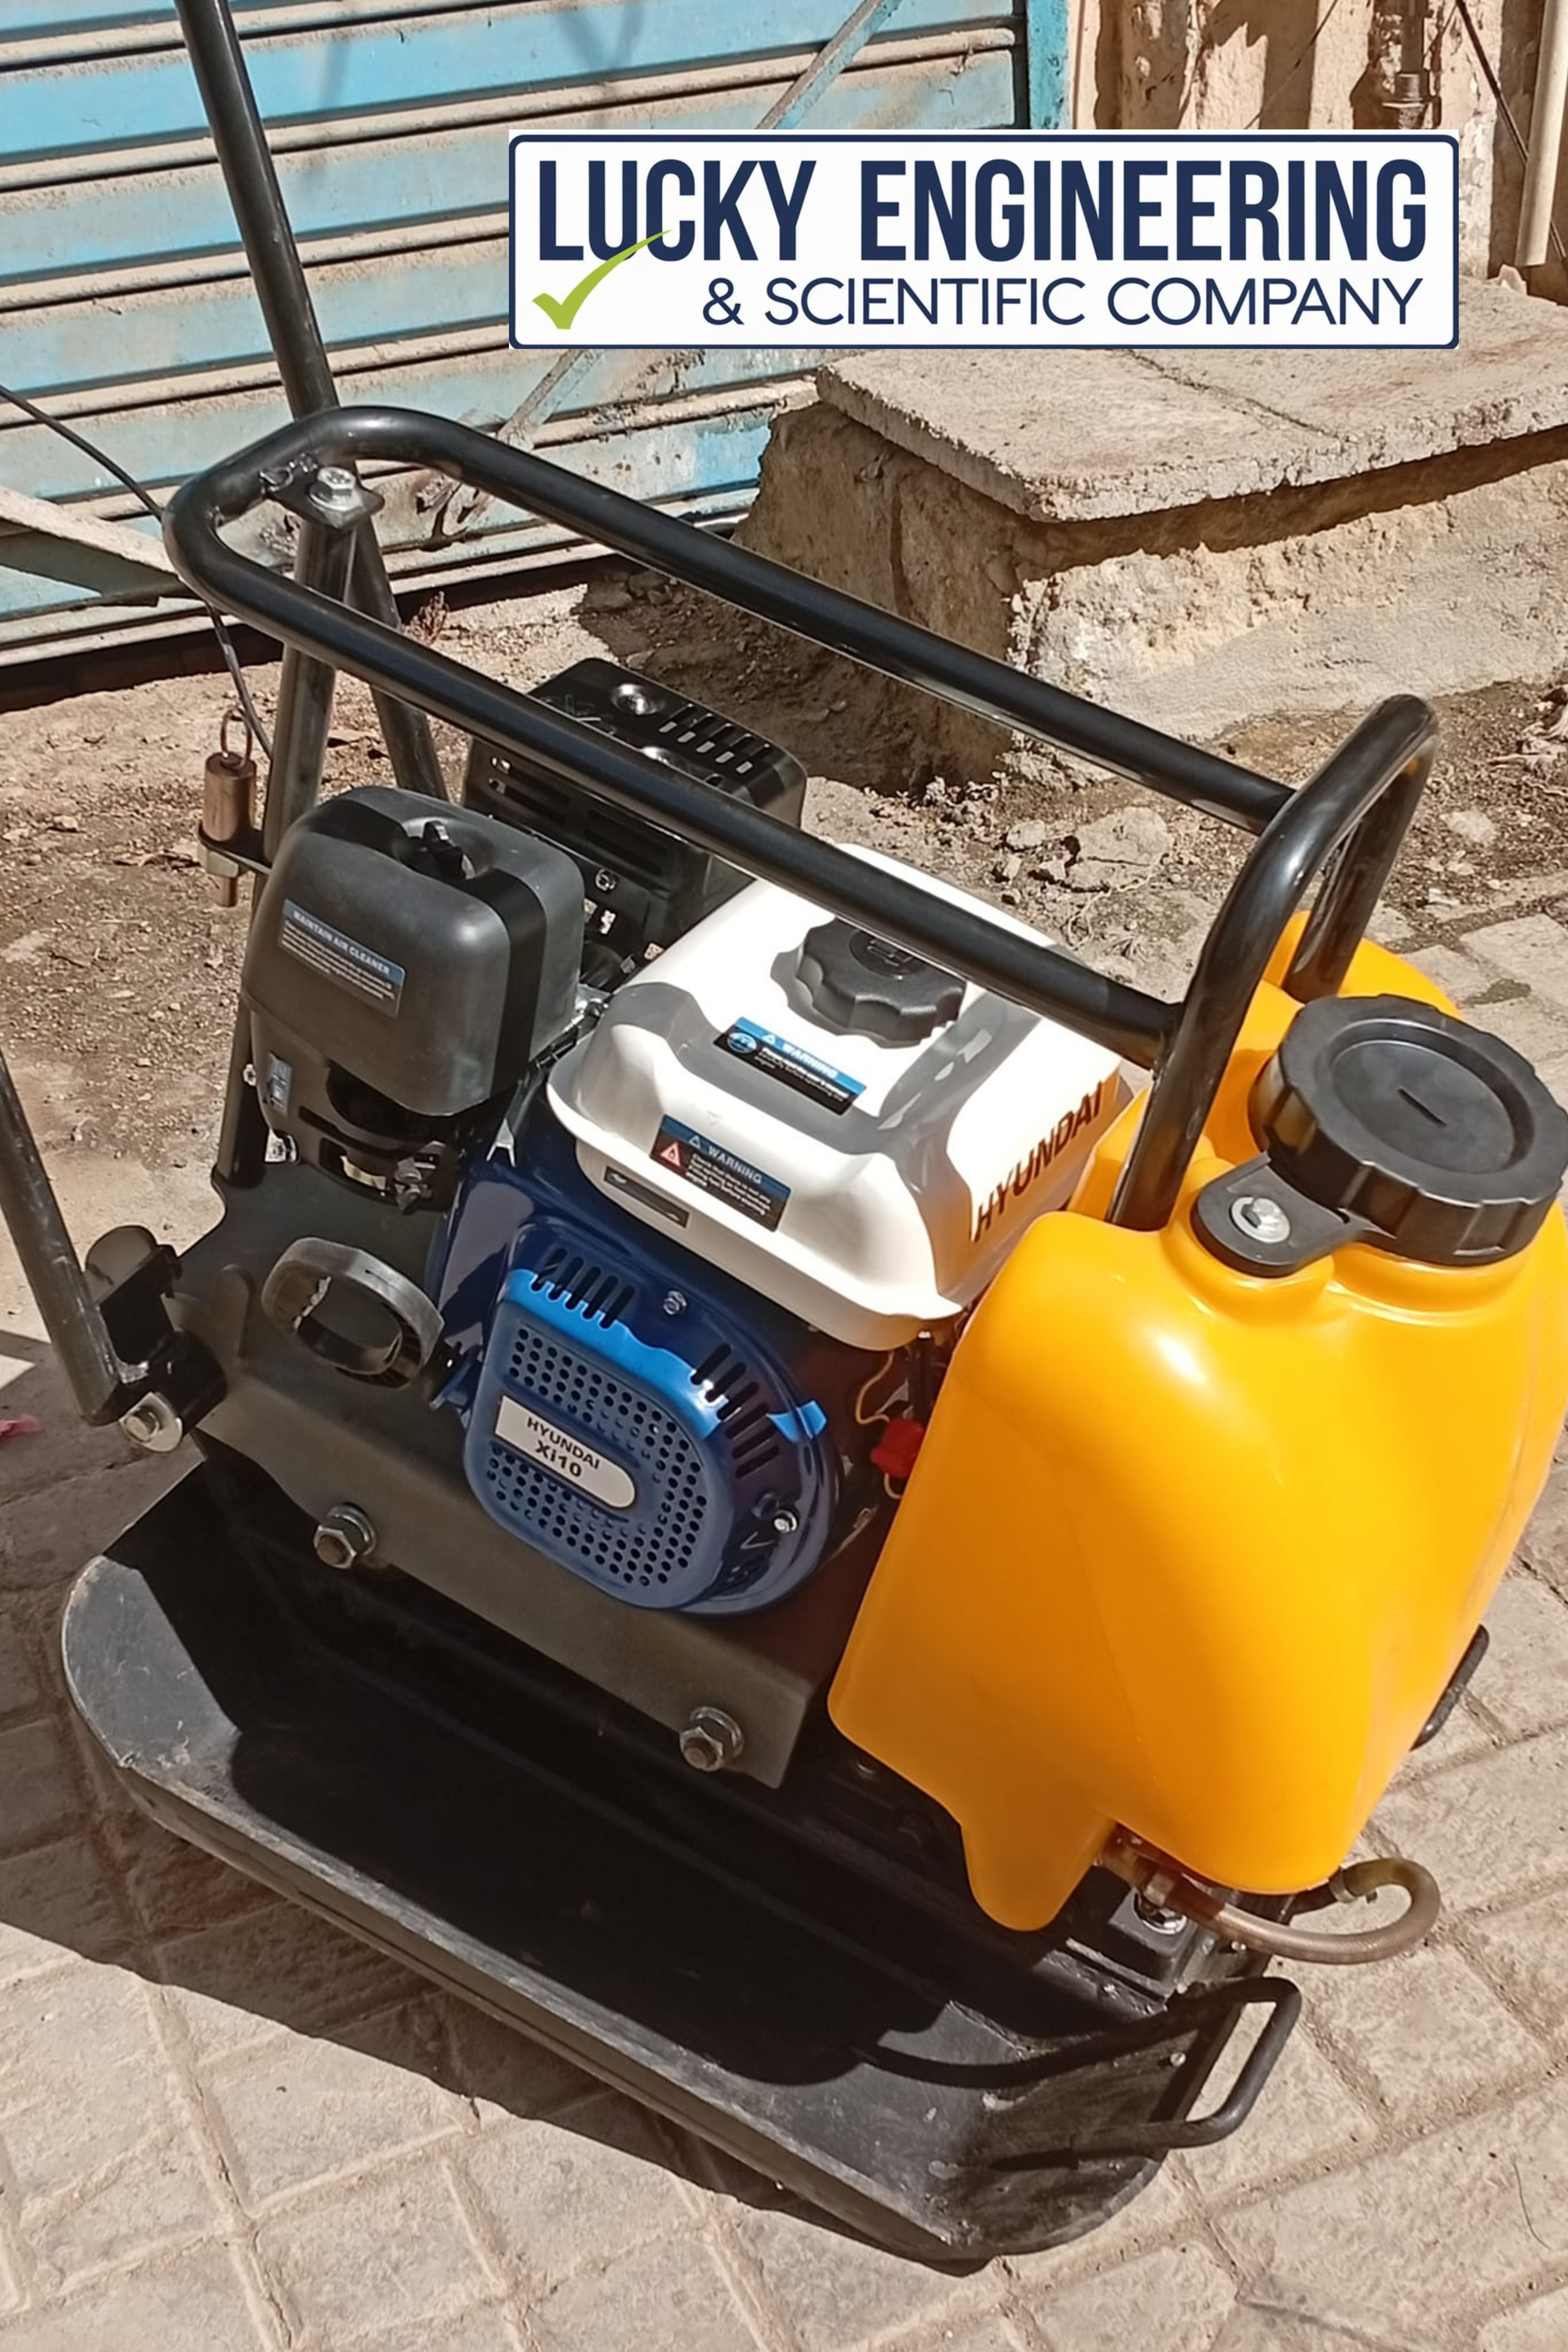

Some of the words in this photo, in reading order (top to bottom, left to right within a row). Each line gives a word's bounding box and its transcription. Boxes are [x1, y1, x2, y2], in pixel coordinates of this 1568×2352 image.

[349, 946, 390, 975] CLEANER
[782, 1042, 838, 1079] WARNING
[708, 1145, 762, 1185] WARNING
[974, 1080, 1102, 1243] HYUNDAI
[526, 1417, 601, 1470] HYUNDAI
[535, 1440, 582, 1477] Xi10
